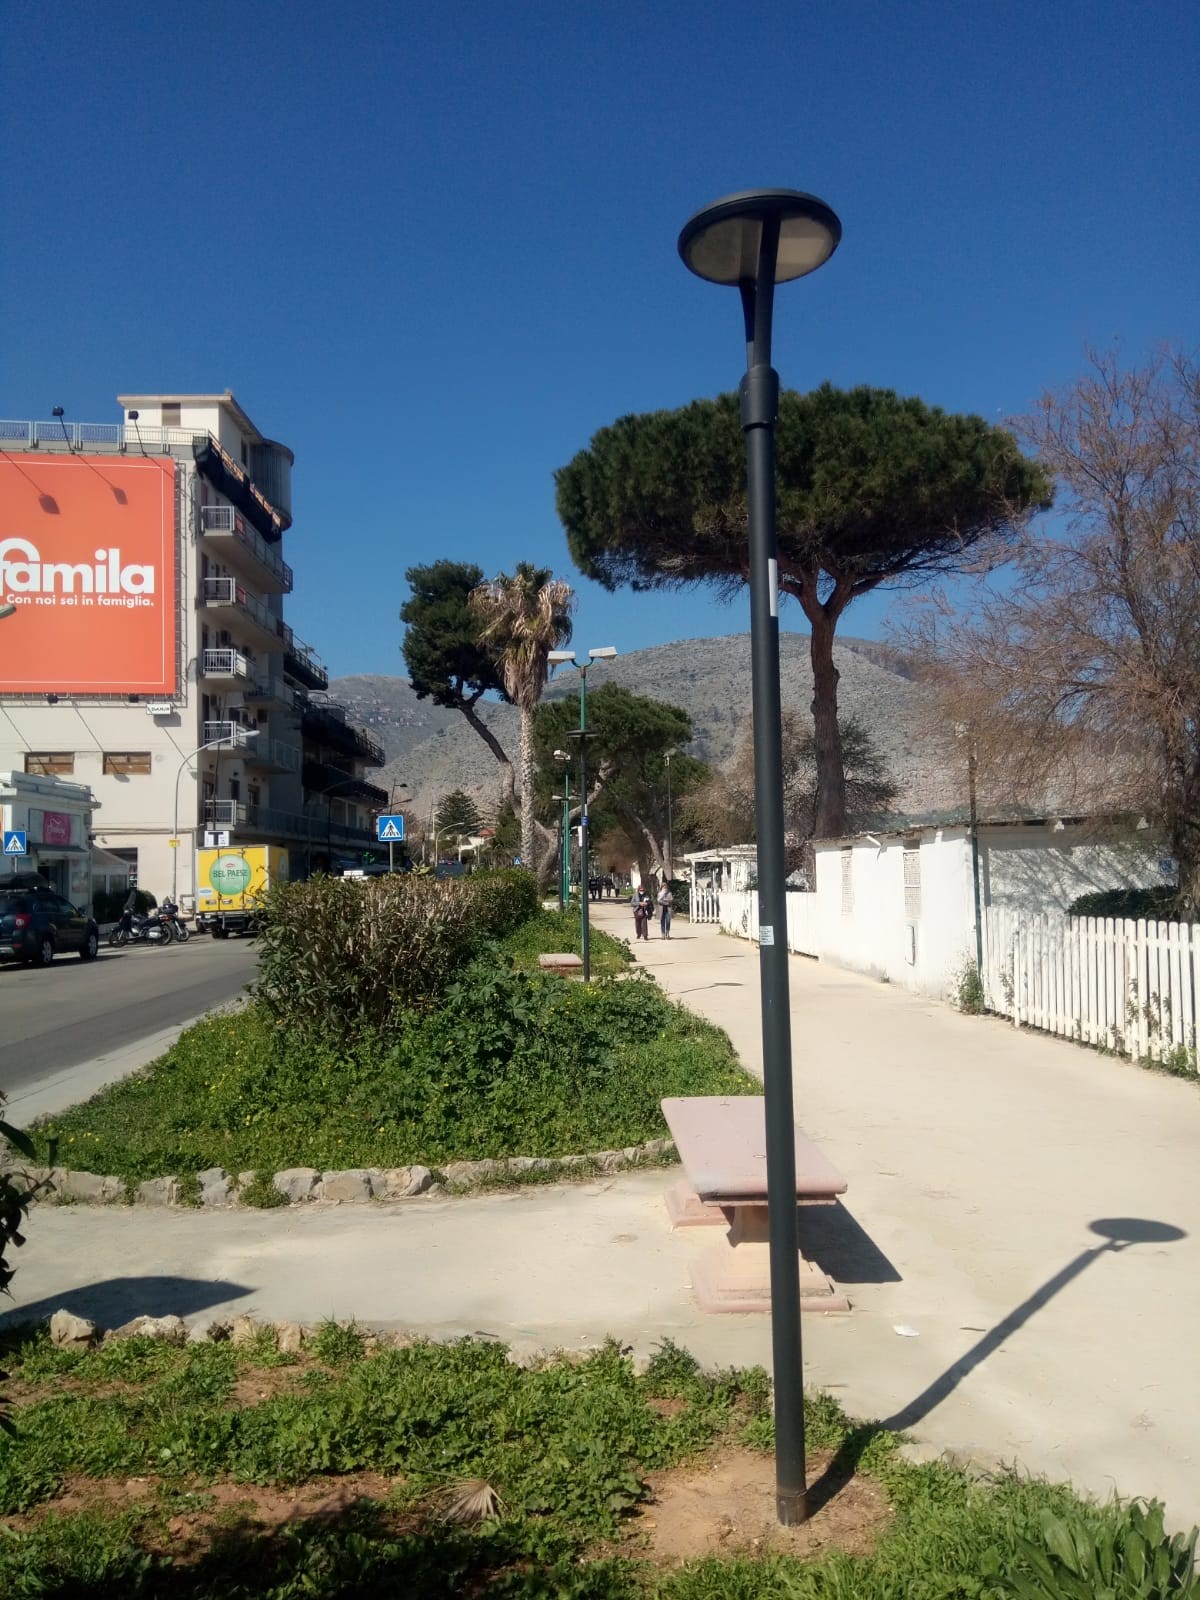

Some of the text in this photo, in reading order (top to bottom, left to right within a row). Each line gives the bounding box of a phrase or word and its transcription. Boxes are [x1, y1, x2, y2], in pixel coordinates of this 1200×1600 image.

[6, 593, 155, 609] Con noi sei in famiglia.
[208, 831, 223, 846] T
[213, 869, 249, 878] BEL PAESE
